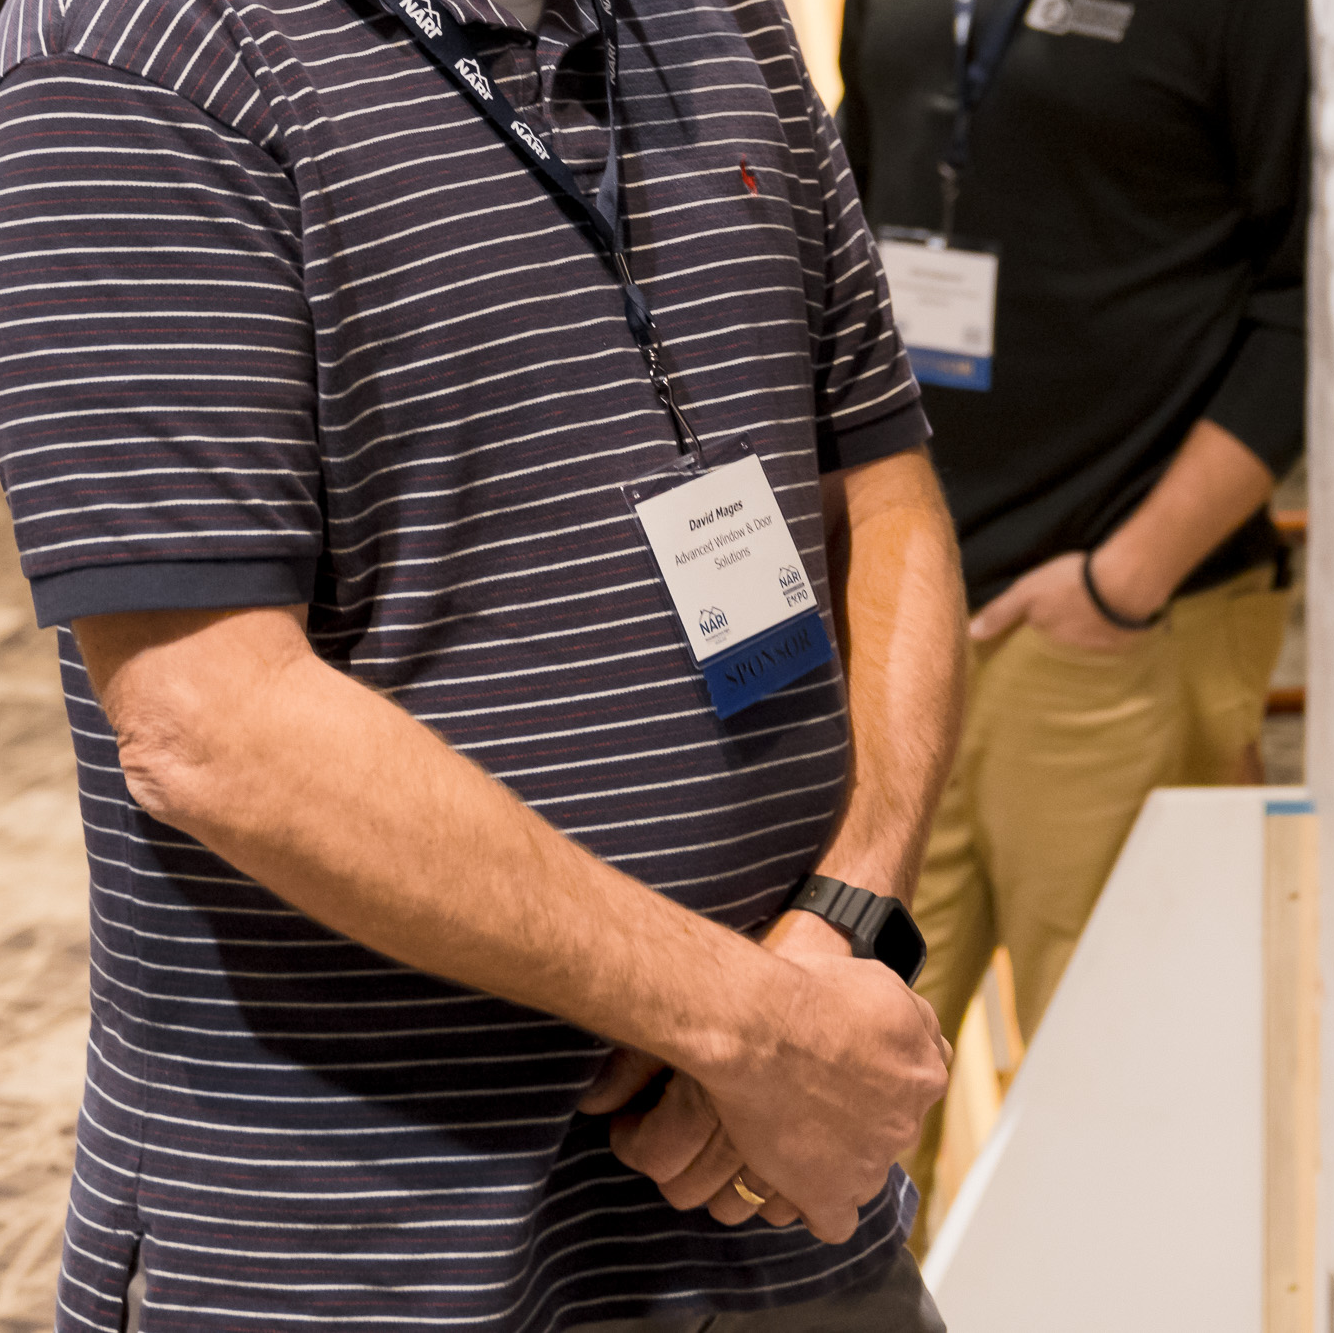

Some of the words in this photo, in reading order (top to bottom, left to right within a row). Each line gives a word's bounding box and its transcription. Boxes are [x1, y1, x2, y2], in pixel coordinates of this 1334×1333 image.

[688, 509, 715, 532] David
[715, 499, 744, 520] Mages
[674, 539, 715, 567] Advanced
[713, 527, 746, 549] Window
[745, 522, 755, 534] &
[753, 514, 773, 531] Door
[714, 546, 752, 570] Solutions
[778, 569, 802, 589] NARI
[785, 589, 809, 608] EXPO
[699, 611, 729, 637] NARI
[724, 627, 812, 689] SPONSOR
